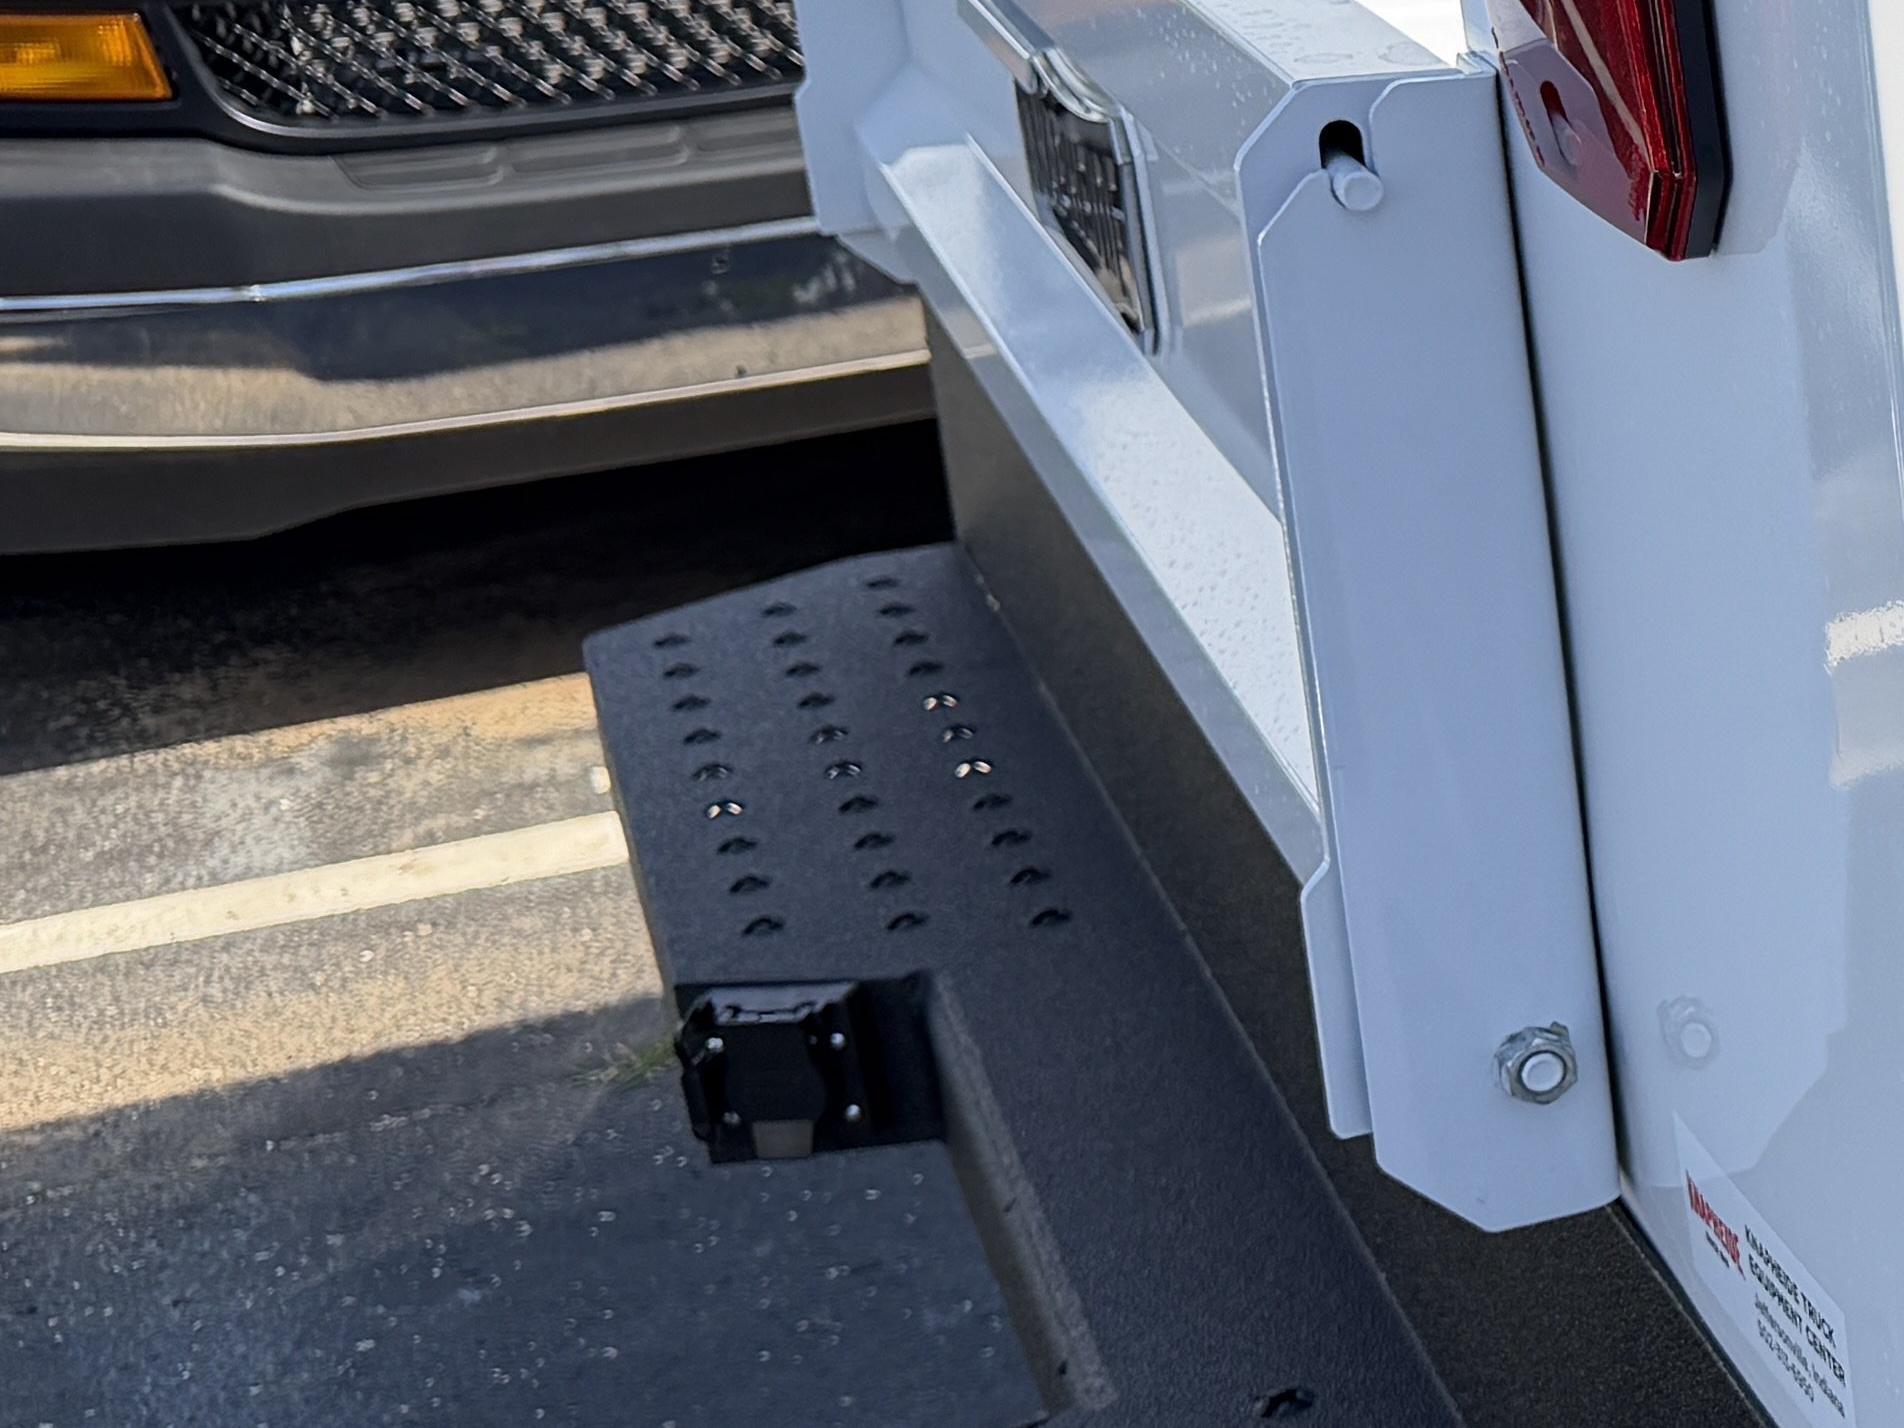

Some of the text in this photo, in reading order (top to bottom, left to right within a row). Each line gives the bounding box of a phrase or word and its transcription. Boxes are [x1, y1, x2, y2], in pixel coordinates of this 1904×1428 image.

[1748, 1253, 1847, 1388] EQUIPMENT CENTER
[1801, 1292, 1837, 1348] TRUCK
